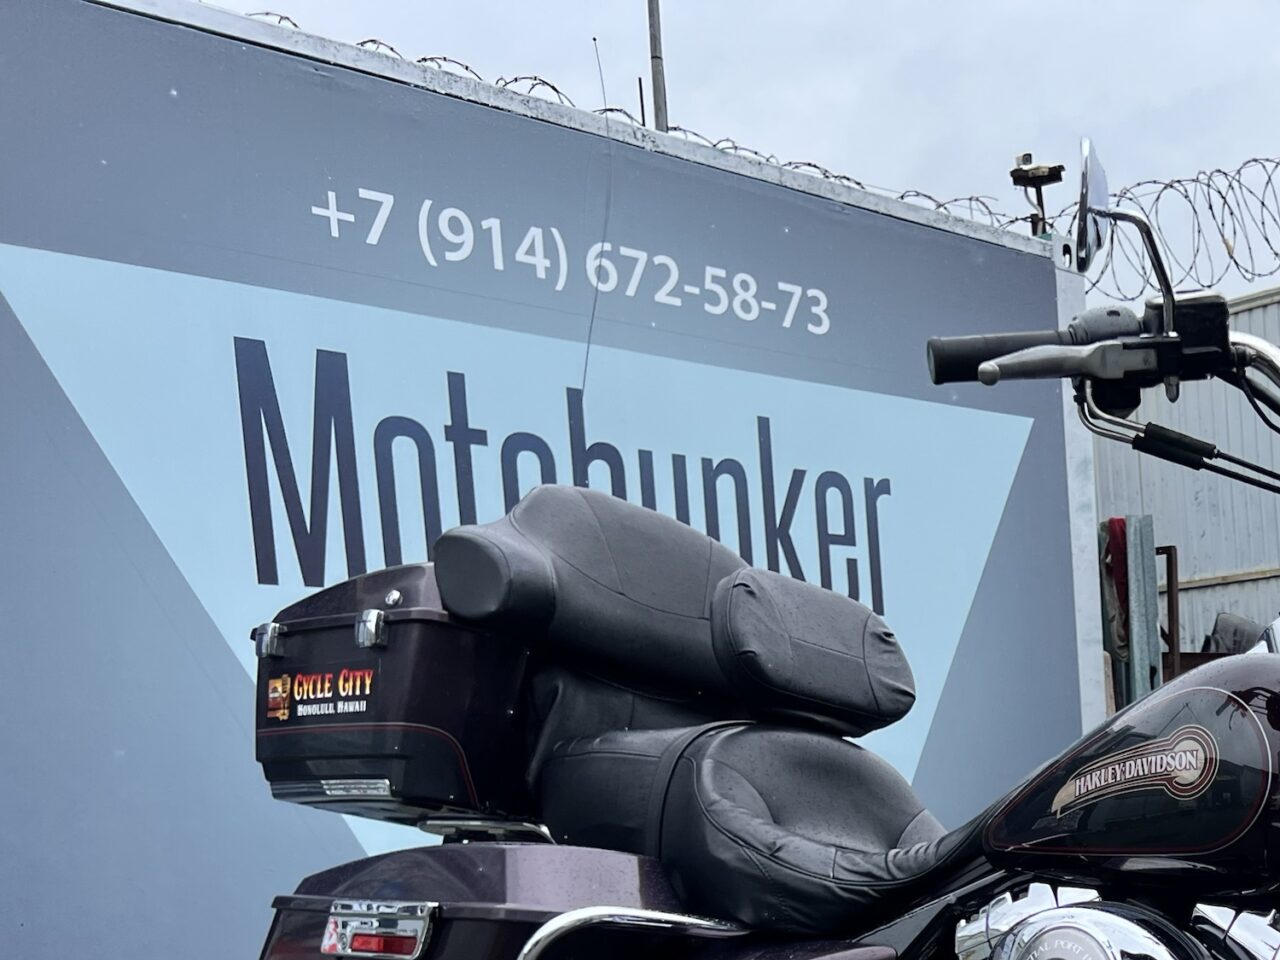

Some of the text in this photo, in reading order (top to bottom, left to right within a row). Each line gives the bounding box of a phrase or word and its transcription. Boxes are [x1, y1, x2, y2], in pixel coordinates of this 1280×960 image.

[311, 187, 831, 336] +7 (914) 672-58-73
[337, 700, 367, 714] HAWAII
[1054, 939, 1085, 956] PORT
